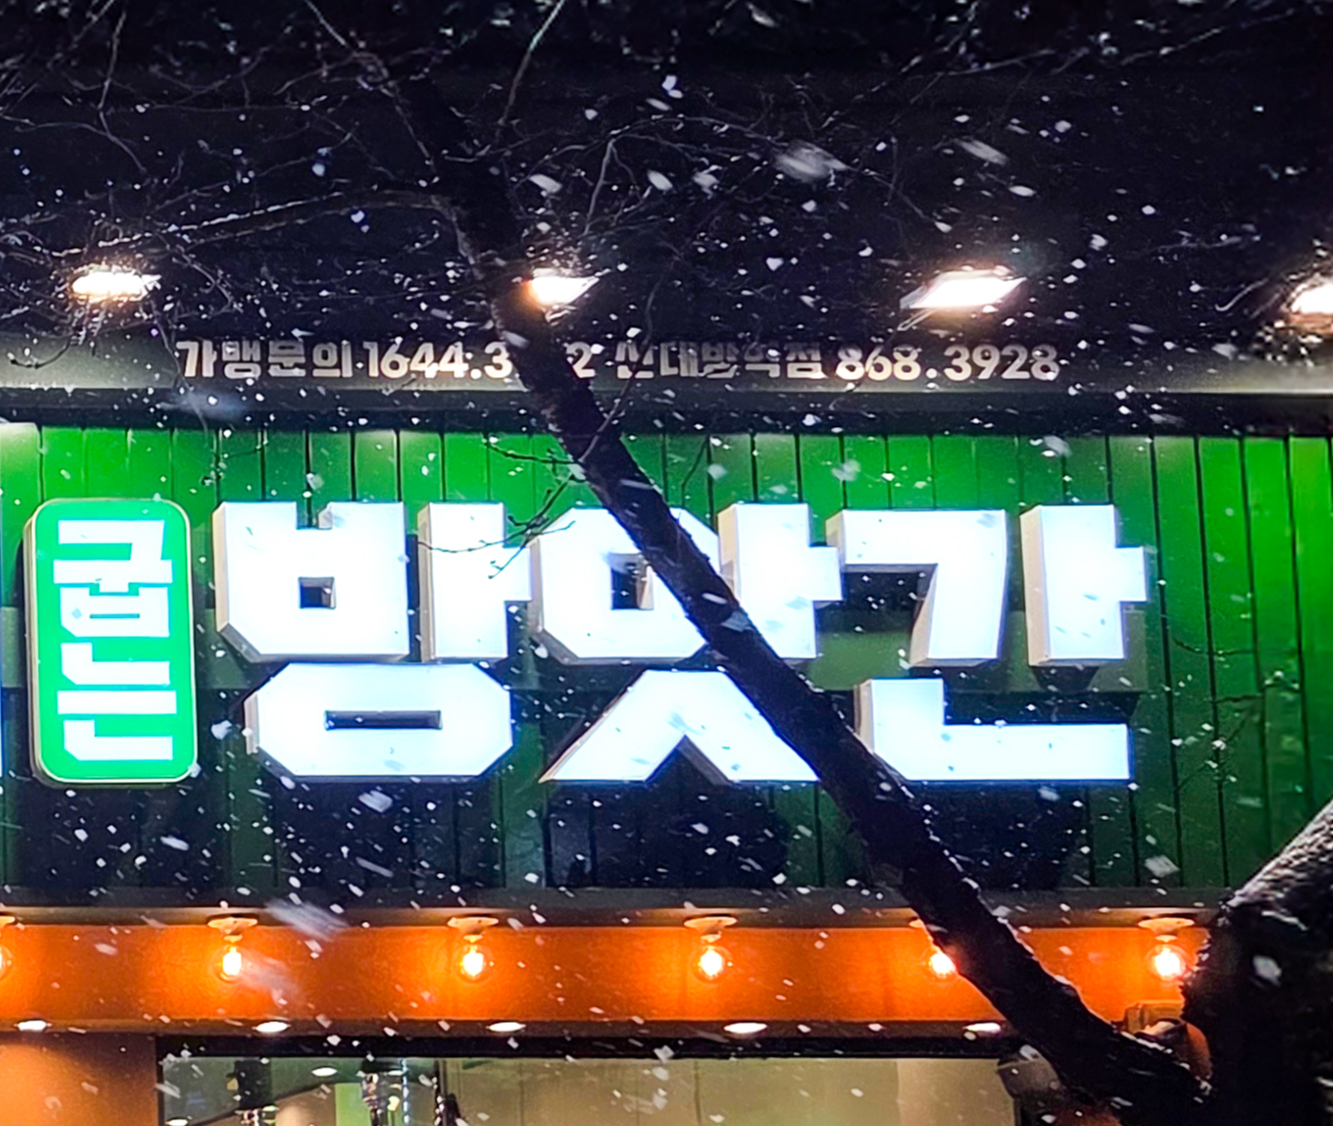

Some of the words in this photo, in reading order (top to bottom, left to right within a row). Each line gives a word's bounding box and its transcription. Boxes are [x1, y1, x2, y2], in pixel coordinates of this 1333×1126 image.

[176, 340, 353, 378] 가맹문의
[362, 340, 596, 379] 1644.32
[615, 341, 827, 379] 신대방역점
[835, 343, 1061, 381] 868.3928
